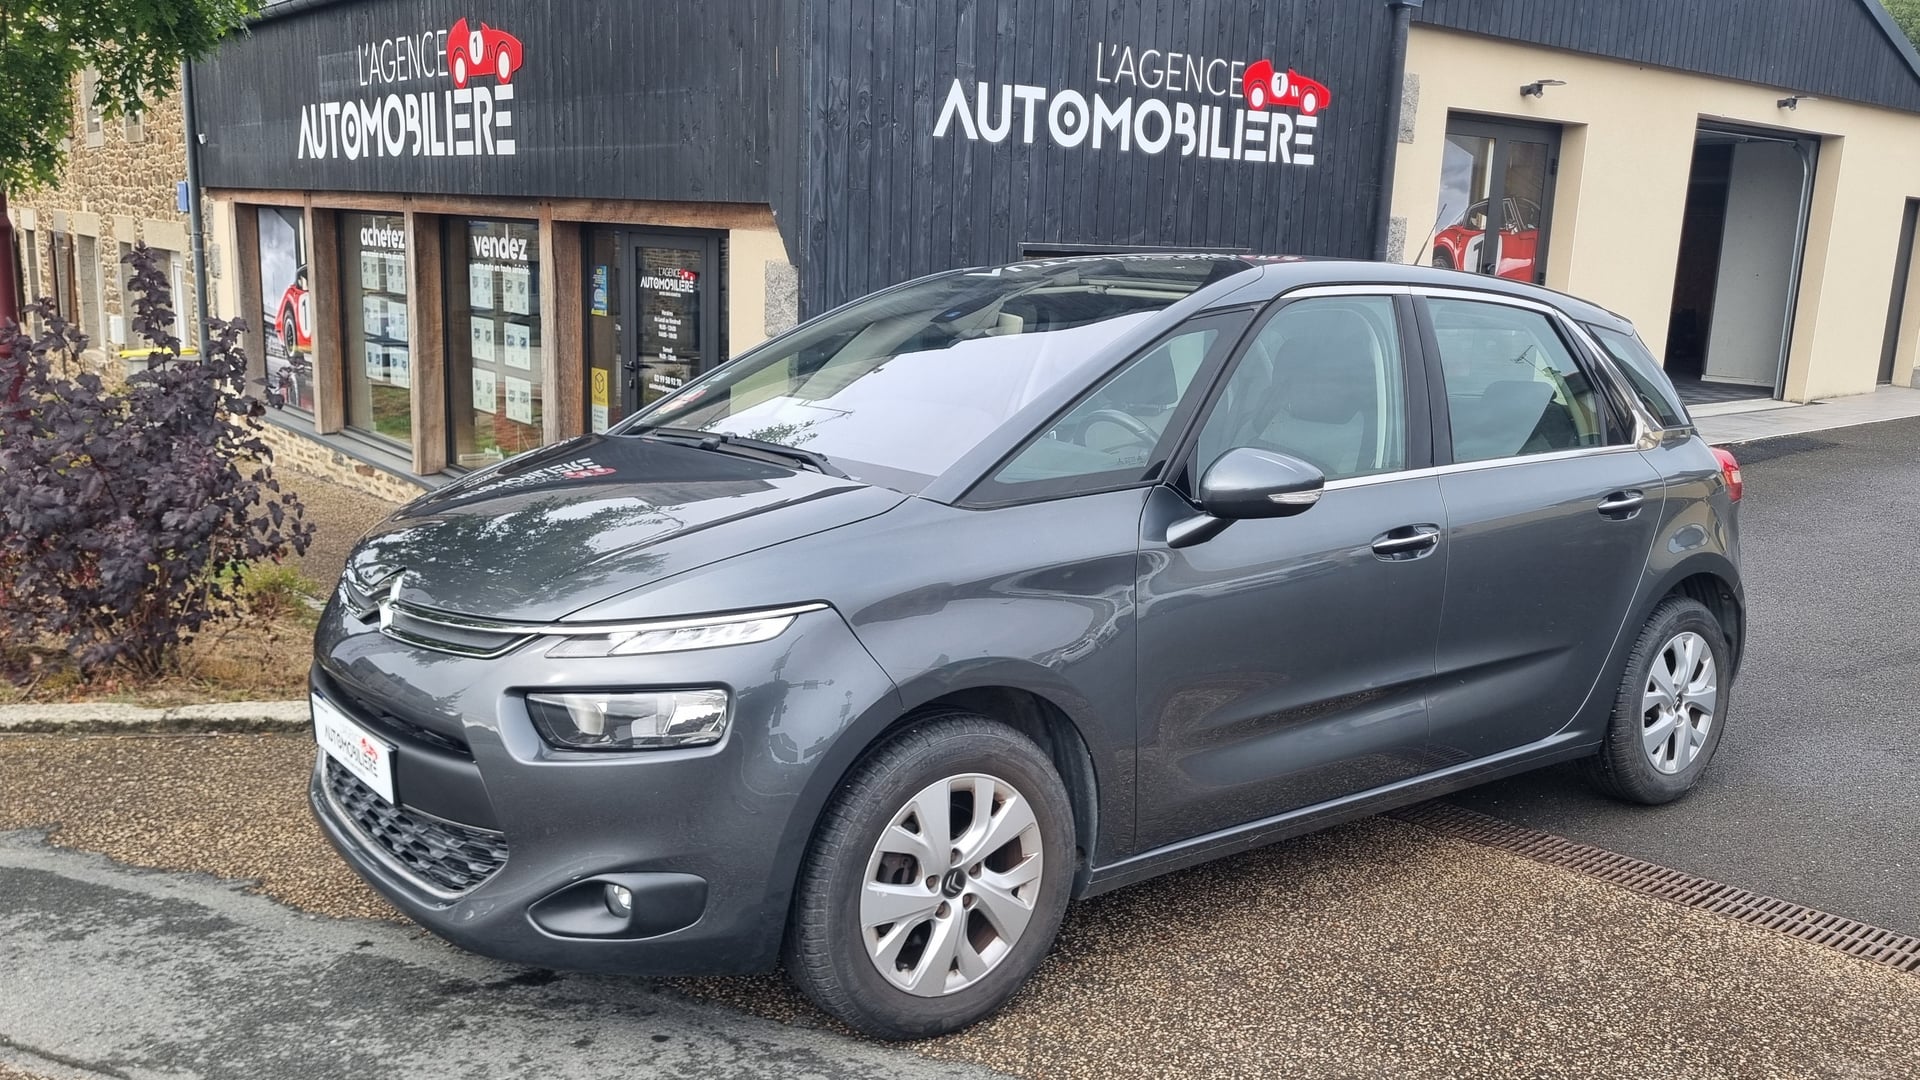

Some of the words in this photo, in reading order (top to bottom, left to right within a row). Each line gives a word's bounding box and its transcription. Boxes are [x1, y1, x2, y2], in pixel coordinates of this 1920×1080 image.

[358, 30, 448, 86] L'AGENCE
[472, 35, 480, 58] 1
[1096, 42, 1245, 98] L'AGENCE
[1276, 74, 1283, 92] 1
[360, 216, 405, 249] achetez
[473, 223, 528, 261] vendez
[658, 267, 681, 278] L'AGENCE
